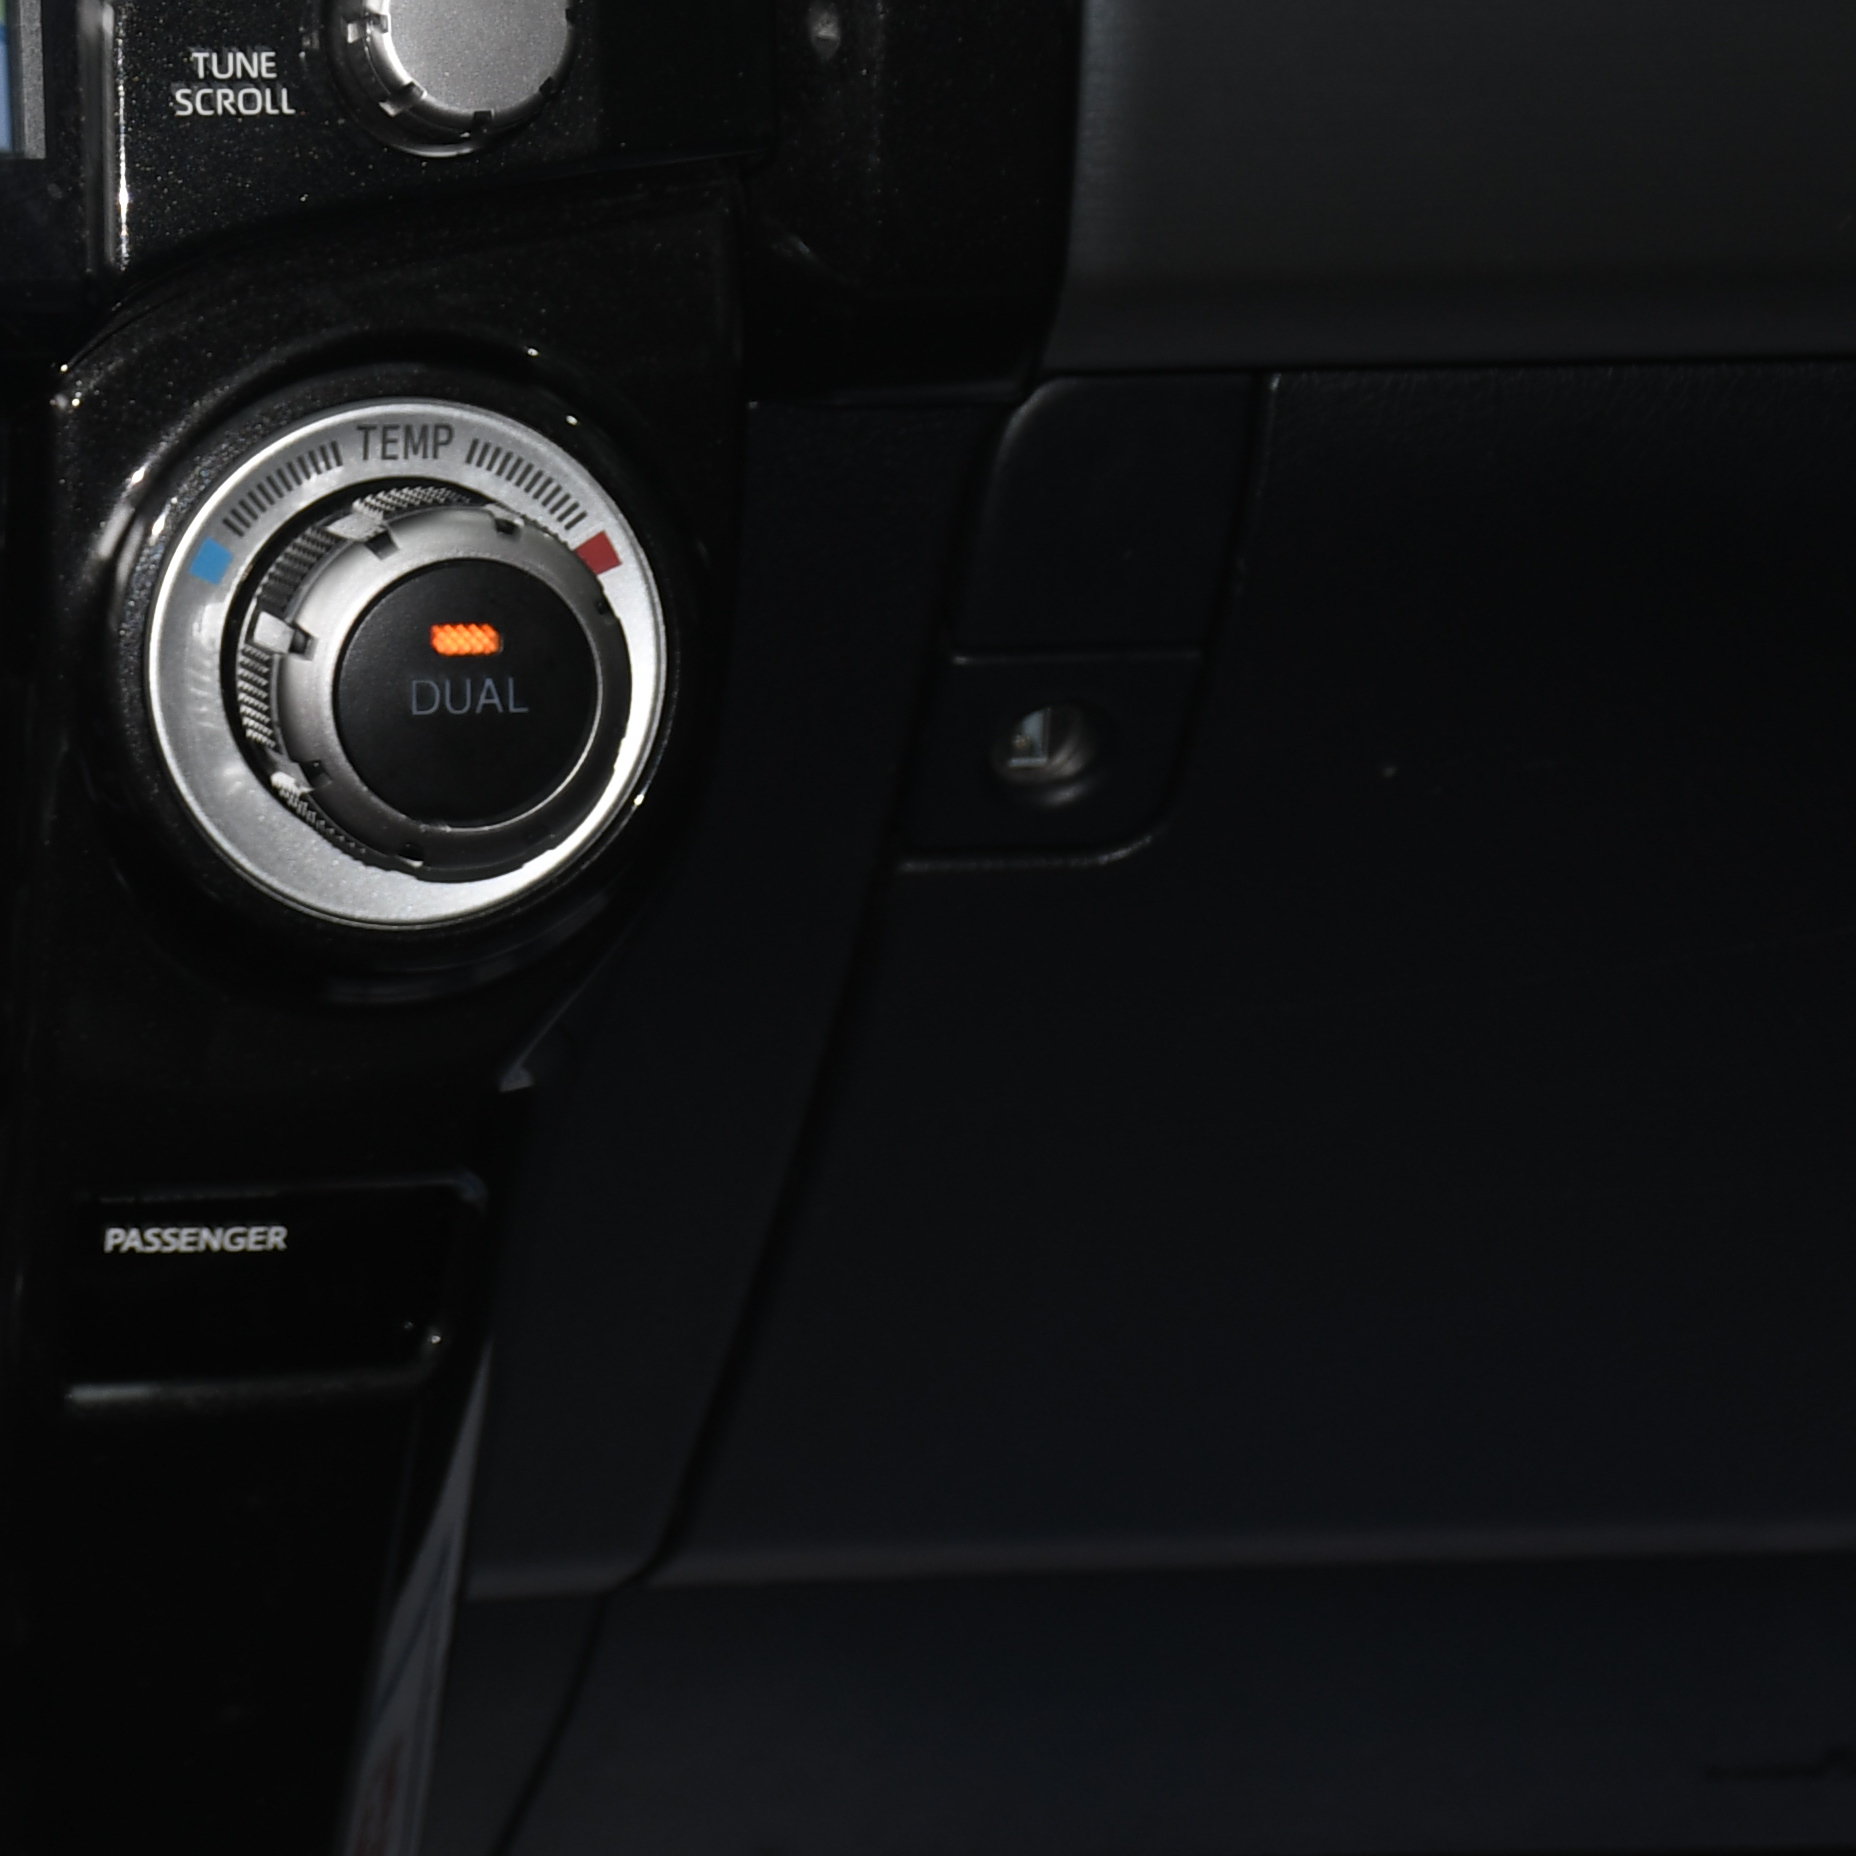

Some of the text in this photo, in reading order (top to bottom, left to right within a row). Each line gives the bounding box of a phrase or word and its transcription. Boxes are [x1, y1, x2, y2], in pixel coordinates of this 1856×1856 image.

[191, 50, 277, 79] TUNE
[174, 88, 296, 116] SCROLL
[356, 423, 453, 462] TEMP
[410, 676, 529, 716] DUAL
[103, 1225, 288, 1253] PASSENGER
